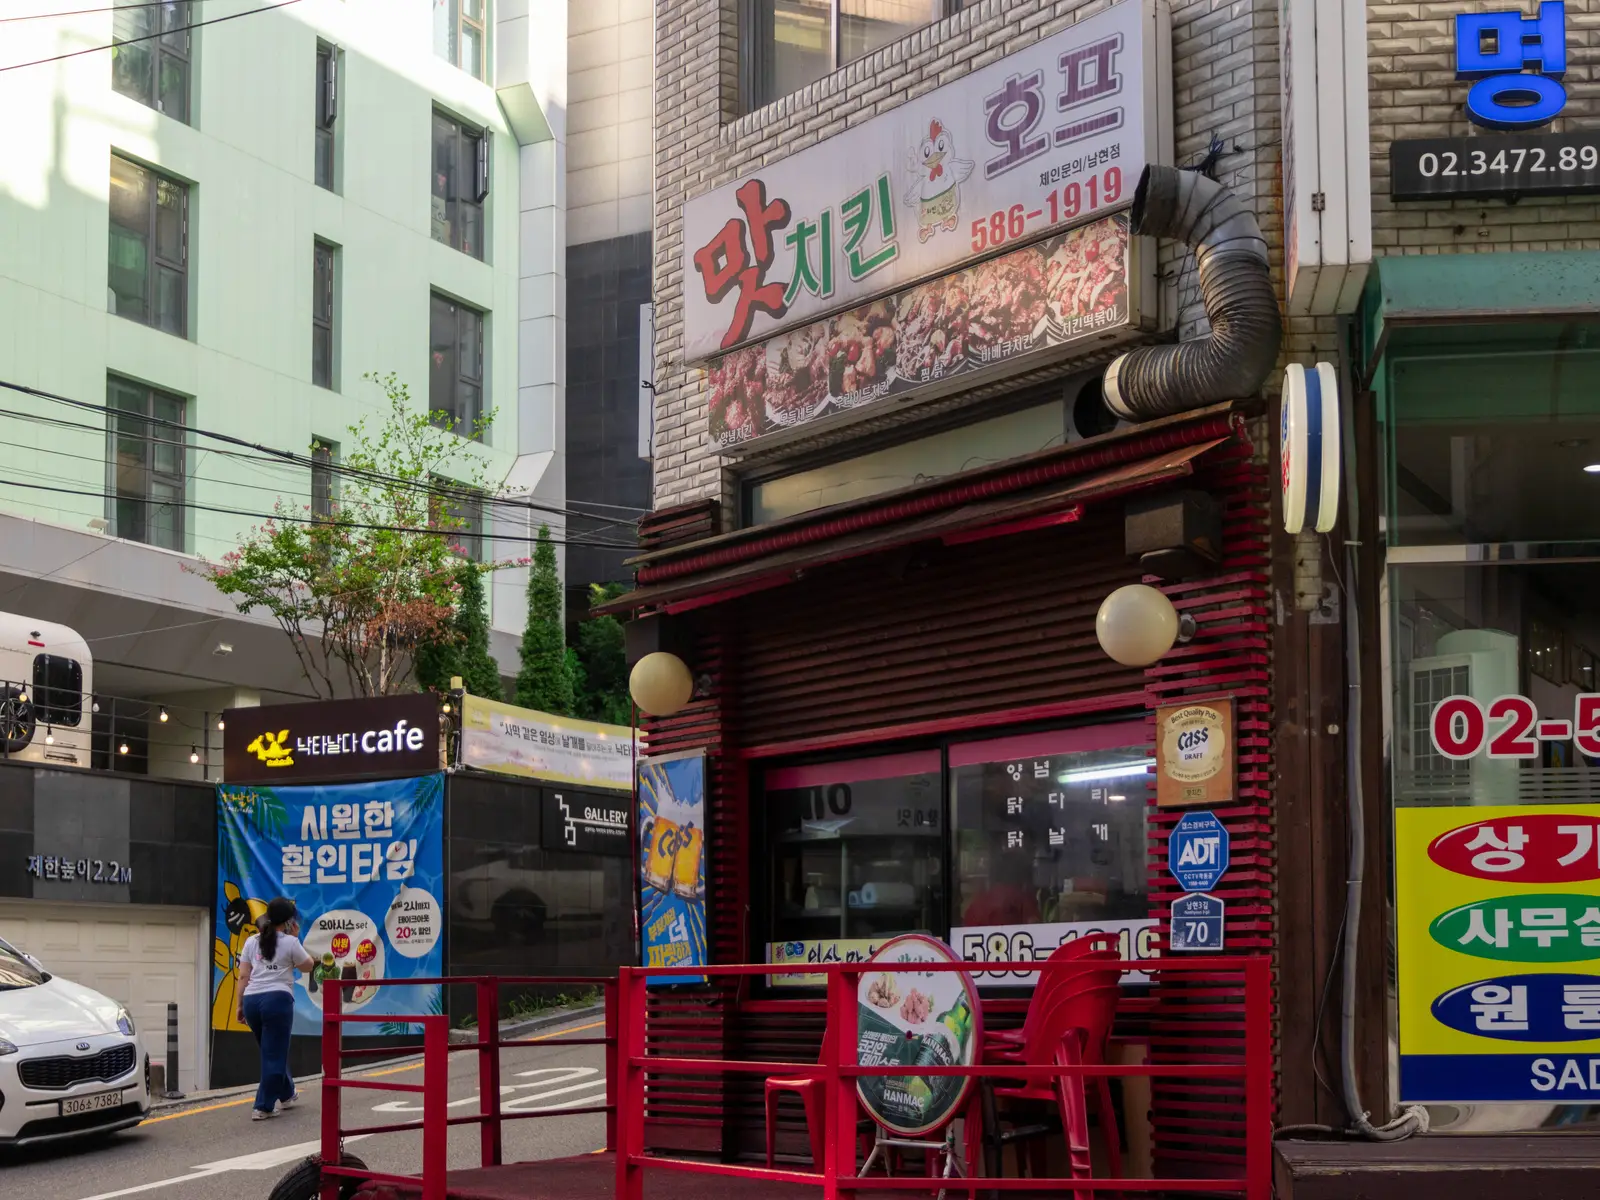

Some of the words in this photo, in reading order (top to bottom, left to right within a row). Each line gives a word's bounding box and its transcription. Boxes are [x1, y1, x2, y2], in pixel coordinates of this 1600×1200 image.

[984, 32, 1124, 180] 호프
[971, 166, 1122, 253] 586-1919
[981, 333, 1034, 362] 바베큐치킨
[720, 424, 753, 446] 양념치킨
[1171, 712, 1184, 724] Best
[1183, 708, 1205, 718] Quality
[1204, 709, 1217, 721] Pub
[297, 732, 359, 756] 낙타날다
[361, 719, 425, 754] cafe
[522, 726, 538, 743] 같은
[1184, 752, 1203, 761] DRAFT
[301, 800, 395, 841] 시원한
[584, 806, 628, 824] GALLERY
[281, 839, 417, 885] 할인타임
[1178, 838, 1220, 866] ADT
[319, 919, 355, 931] 오아시스
[356, 921, 369, 930] set
[1185, 921, 1209, 943] 70
[857, 1039, 888, 1056] 코리안
[94, 1092, 119, 1109] 7382
[883, 1089, 925, 1108] HANMAC
